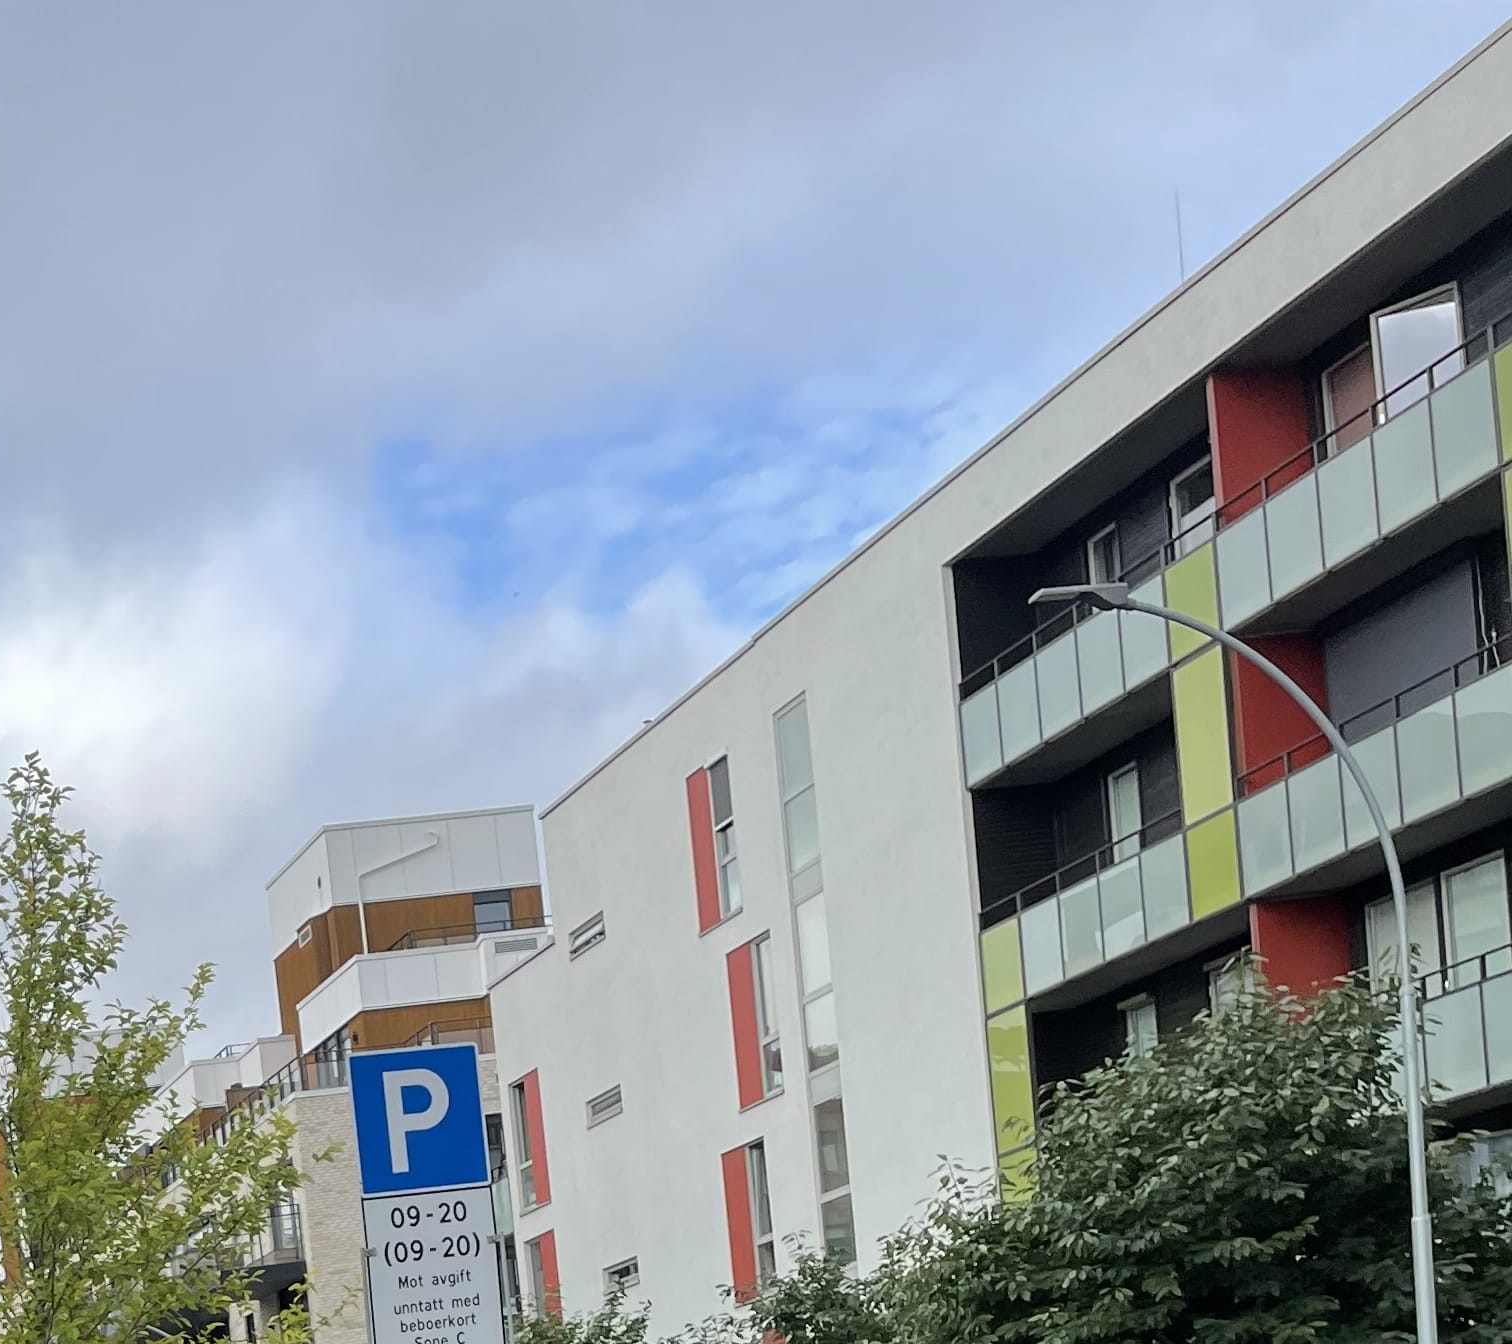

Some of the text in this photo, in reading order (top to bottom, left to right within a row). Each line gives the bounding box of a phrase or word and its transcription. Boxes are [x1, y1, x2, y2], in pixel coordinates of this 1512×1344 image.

[382, 1068, 449, 1174] P
[391, 1201, 467, 1228] 09-20
[398, 1269, 471, 1289] Mot avgift
[394, 1292, 480, 1315] unntatt med
[400, 1313, 476, 1333] beboerkort
[456, 1332, 465, 1344] C
